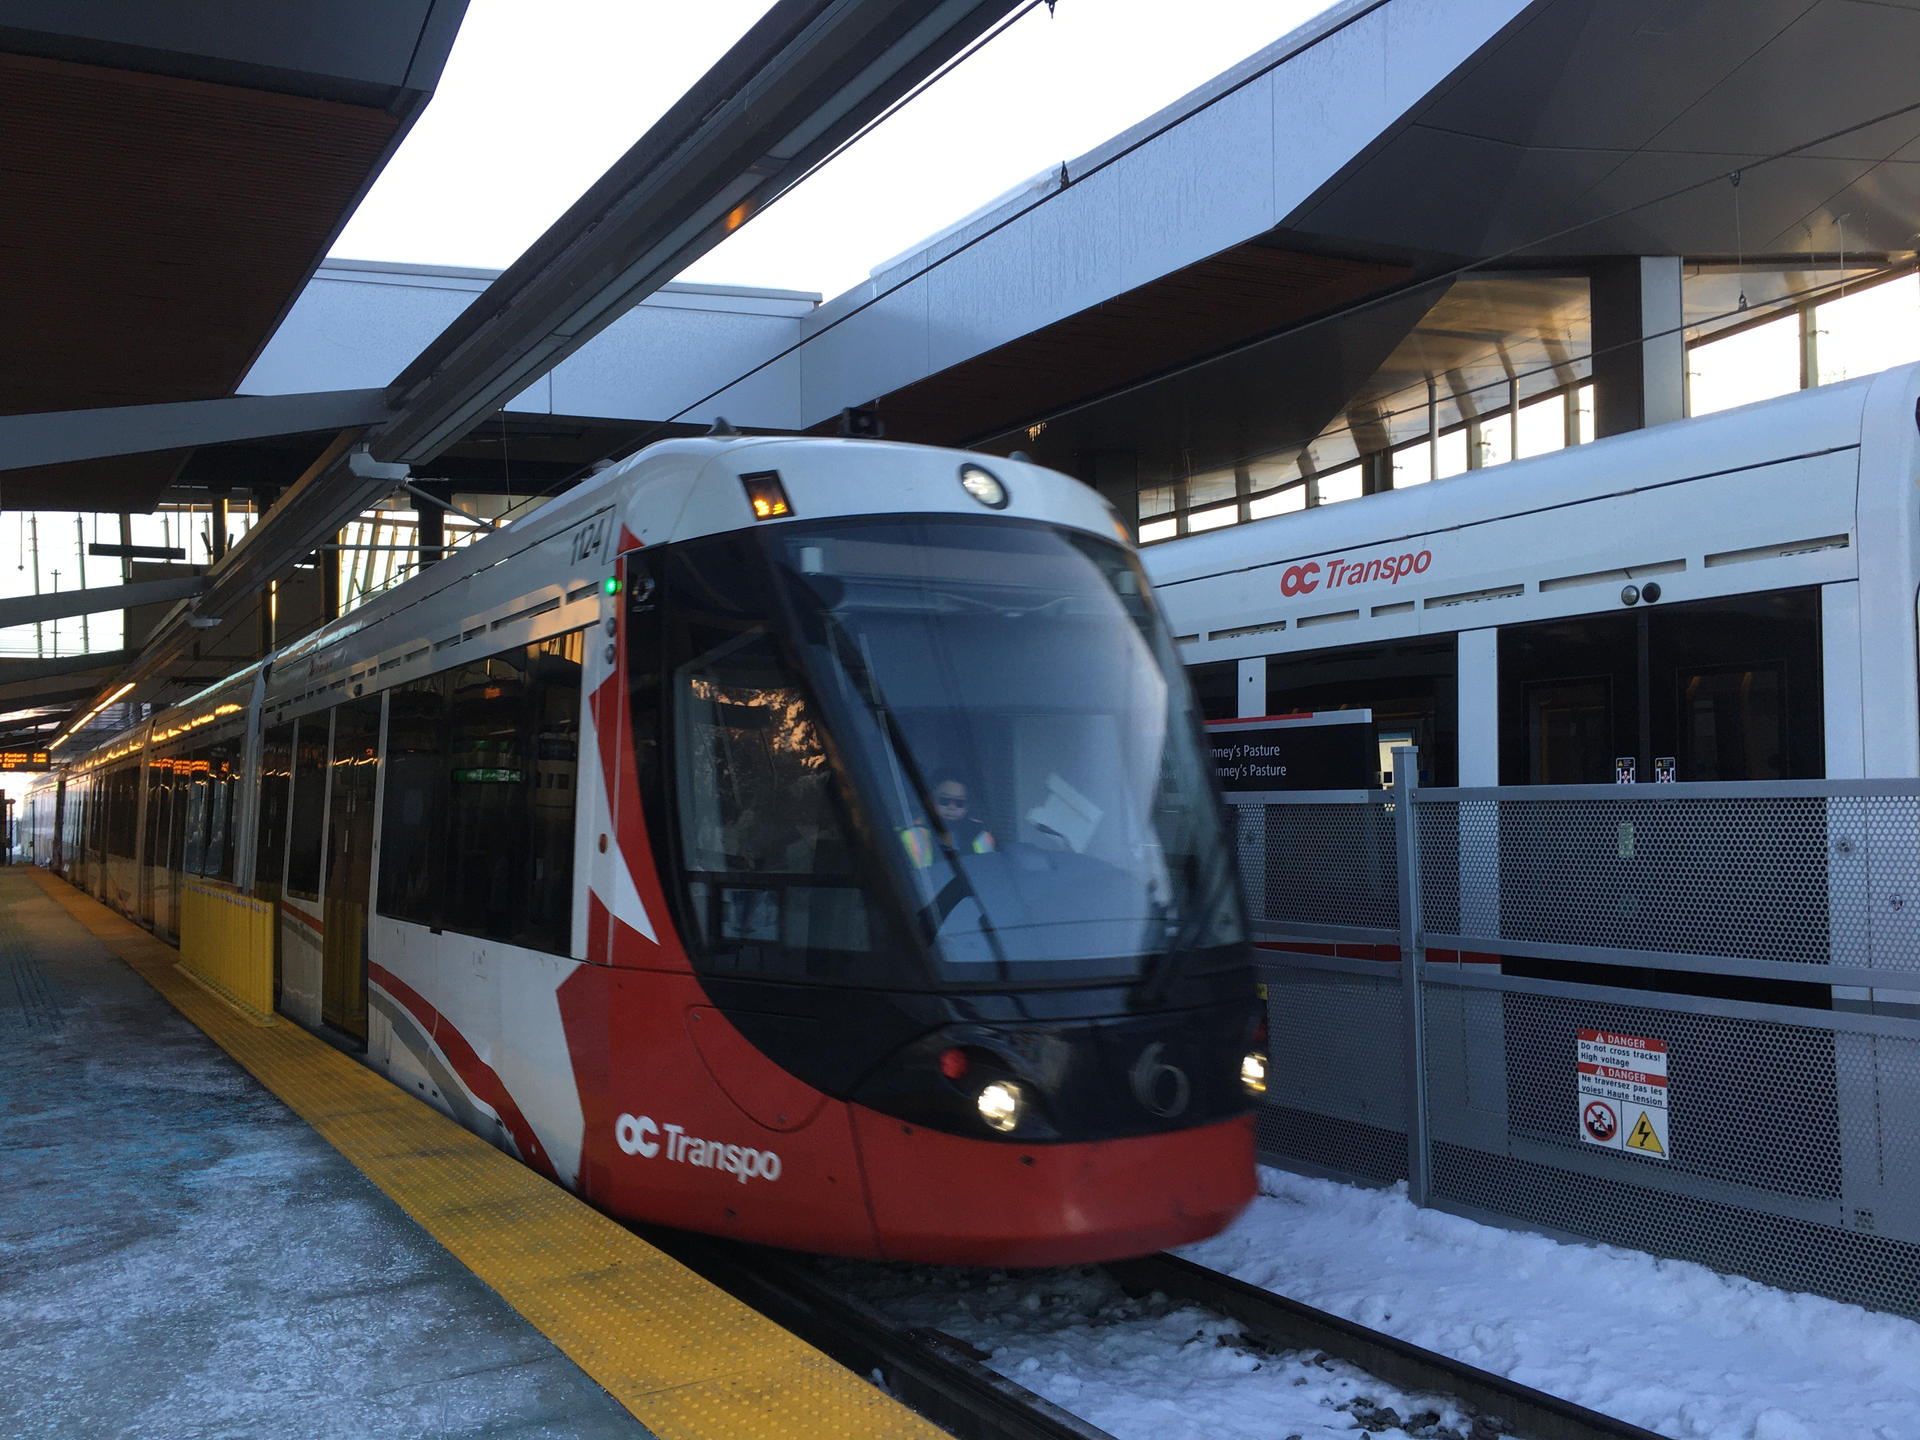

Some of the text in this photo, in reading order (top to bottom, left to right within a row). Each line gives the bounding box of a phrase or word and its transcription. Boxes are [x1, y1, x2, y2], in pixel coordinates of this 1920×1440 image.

[1280, 550, 1432, 598] OC Transpo
[1243, 744, 1280, 758] Pasture
[1250, 764, 1287, 776] Pasture
[1607, 1034, 1645, 1049] DANGER
[1580, 1042, 1661, 1062] Do not cross tracks!
[1580, 1052, 1630, 1068] High voltage
[1608, 1068, 1646, 1083] DANGER
[1581, 1074, 1663, 1096] Ne traversez pas les
[1581, 1085, 1663, 1106] voies! Haute tension
[615, 1113, 782, 1184] OC Transpo
